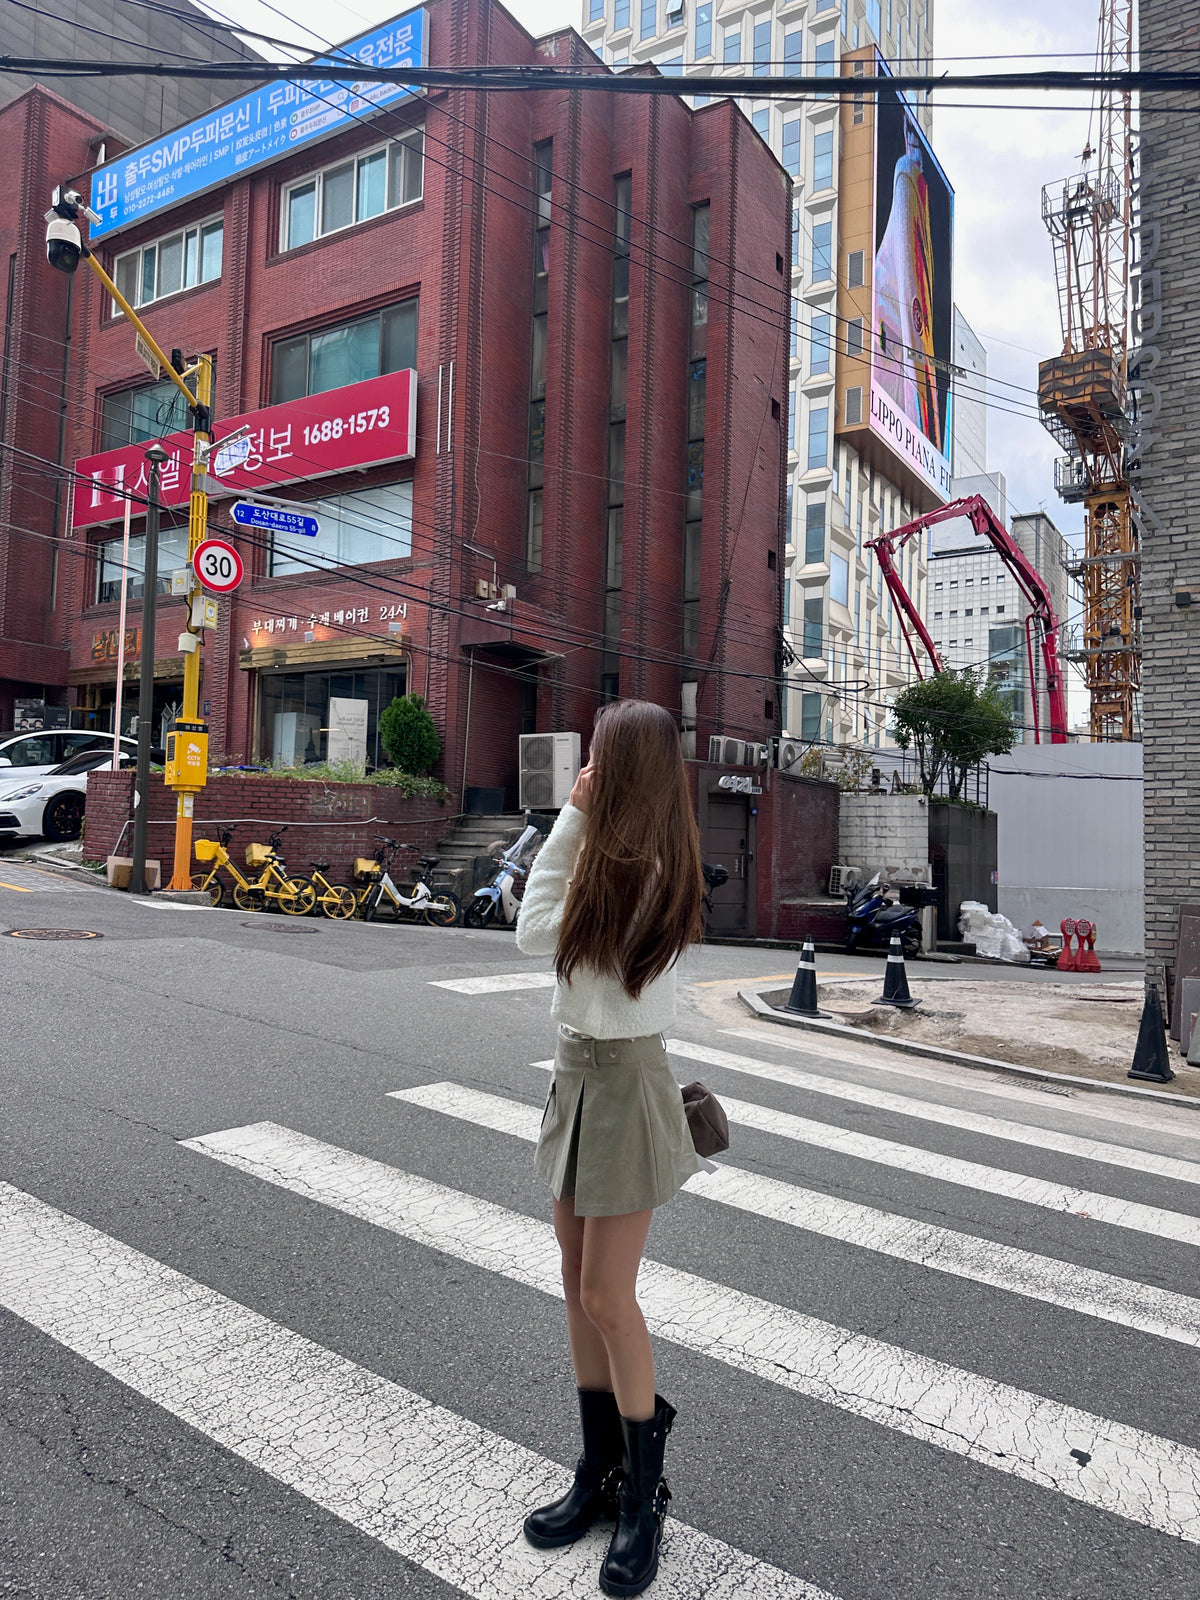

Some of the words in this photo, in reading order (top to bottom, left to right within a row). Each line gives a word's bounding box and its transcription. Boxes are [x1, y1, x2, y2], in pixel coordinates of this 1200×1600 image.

[124, 103, 250, 188] 출두SMP두피문신
[344, 24, 414, 71] 육전문
[213, 145, 230, 160] SMP
[123, 184, 175, 216] 010-2272-4485
[303, 405, 390, 446] 1688-1573
[871, 389, 903, 442] LIPPO
[905, 427, 936, 479] PIANA
[236, 509, 245, 518] 12
[253, 508, 304, 527] 도산대로55길
[250, 517, 289, 531] Dosan-daero
[289, 525, 306, 534] 55-gil
[311, 524, 316, 532] 8
[205, 553, 232, 578] 30
[333, 606, 370, 626] 베이컨
[379, 602, 407, 621] 24시
